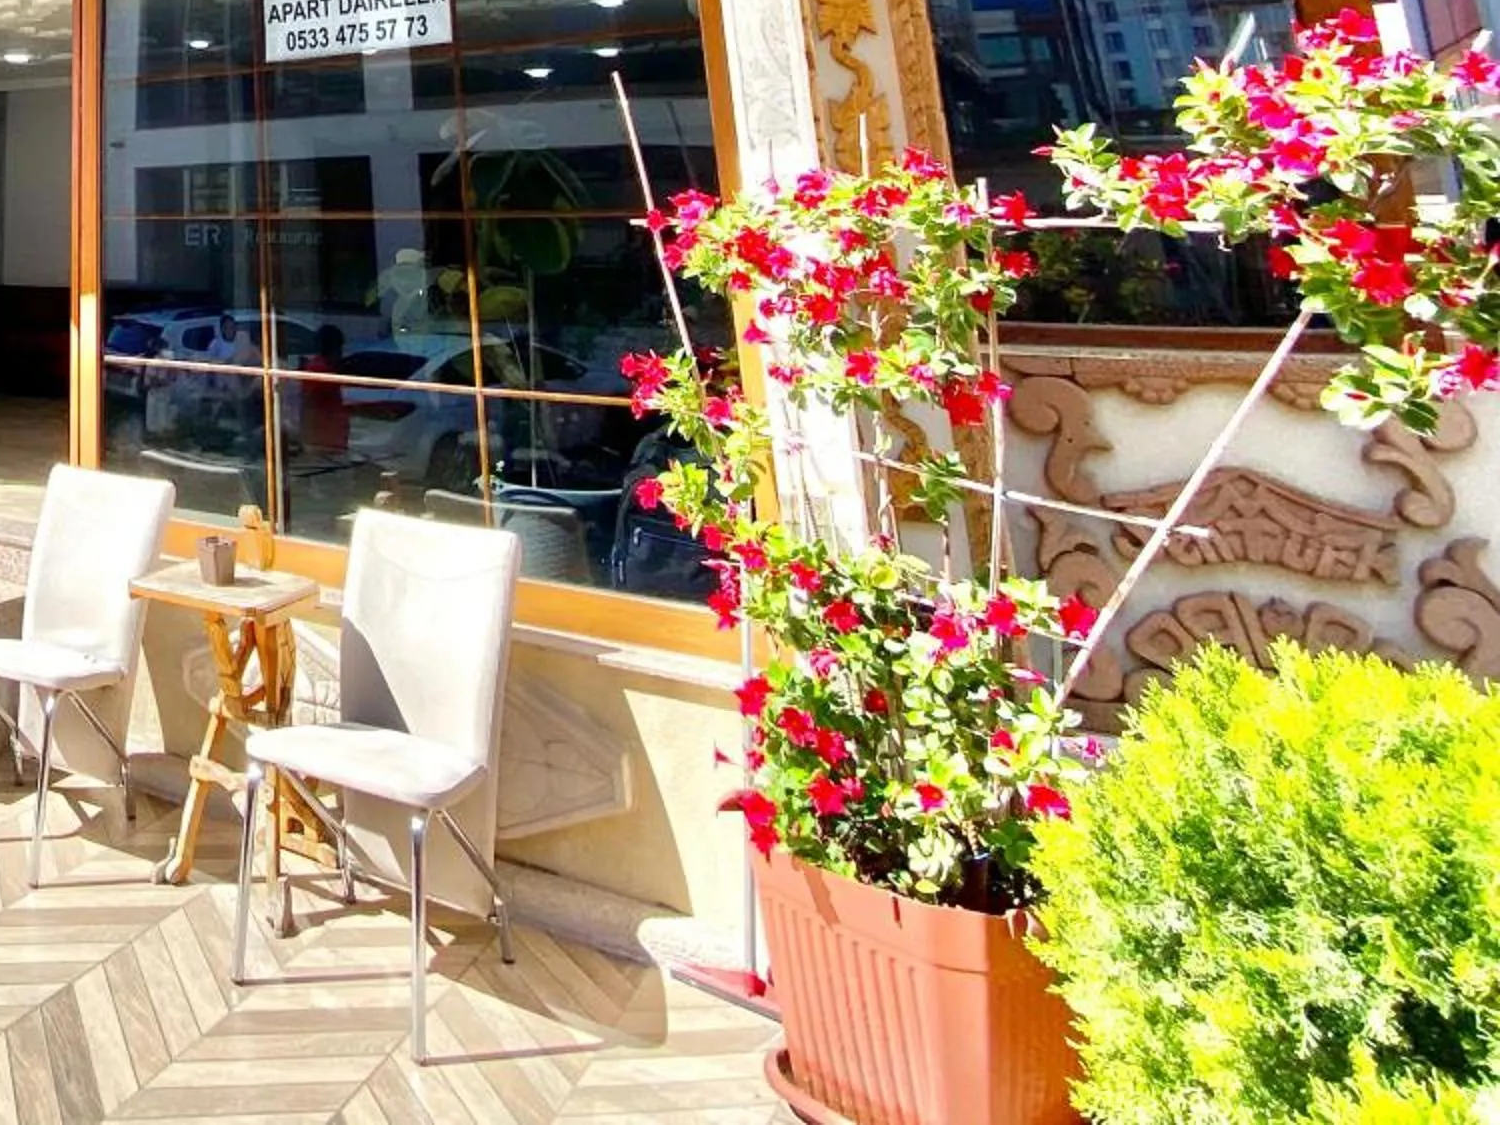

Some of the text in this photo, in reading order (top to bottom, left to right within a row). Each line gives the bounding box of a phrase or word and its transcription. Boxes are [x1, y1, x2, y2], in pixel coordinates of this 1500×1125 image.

[285, 14, 428, 51] 0533 475 57 73
